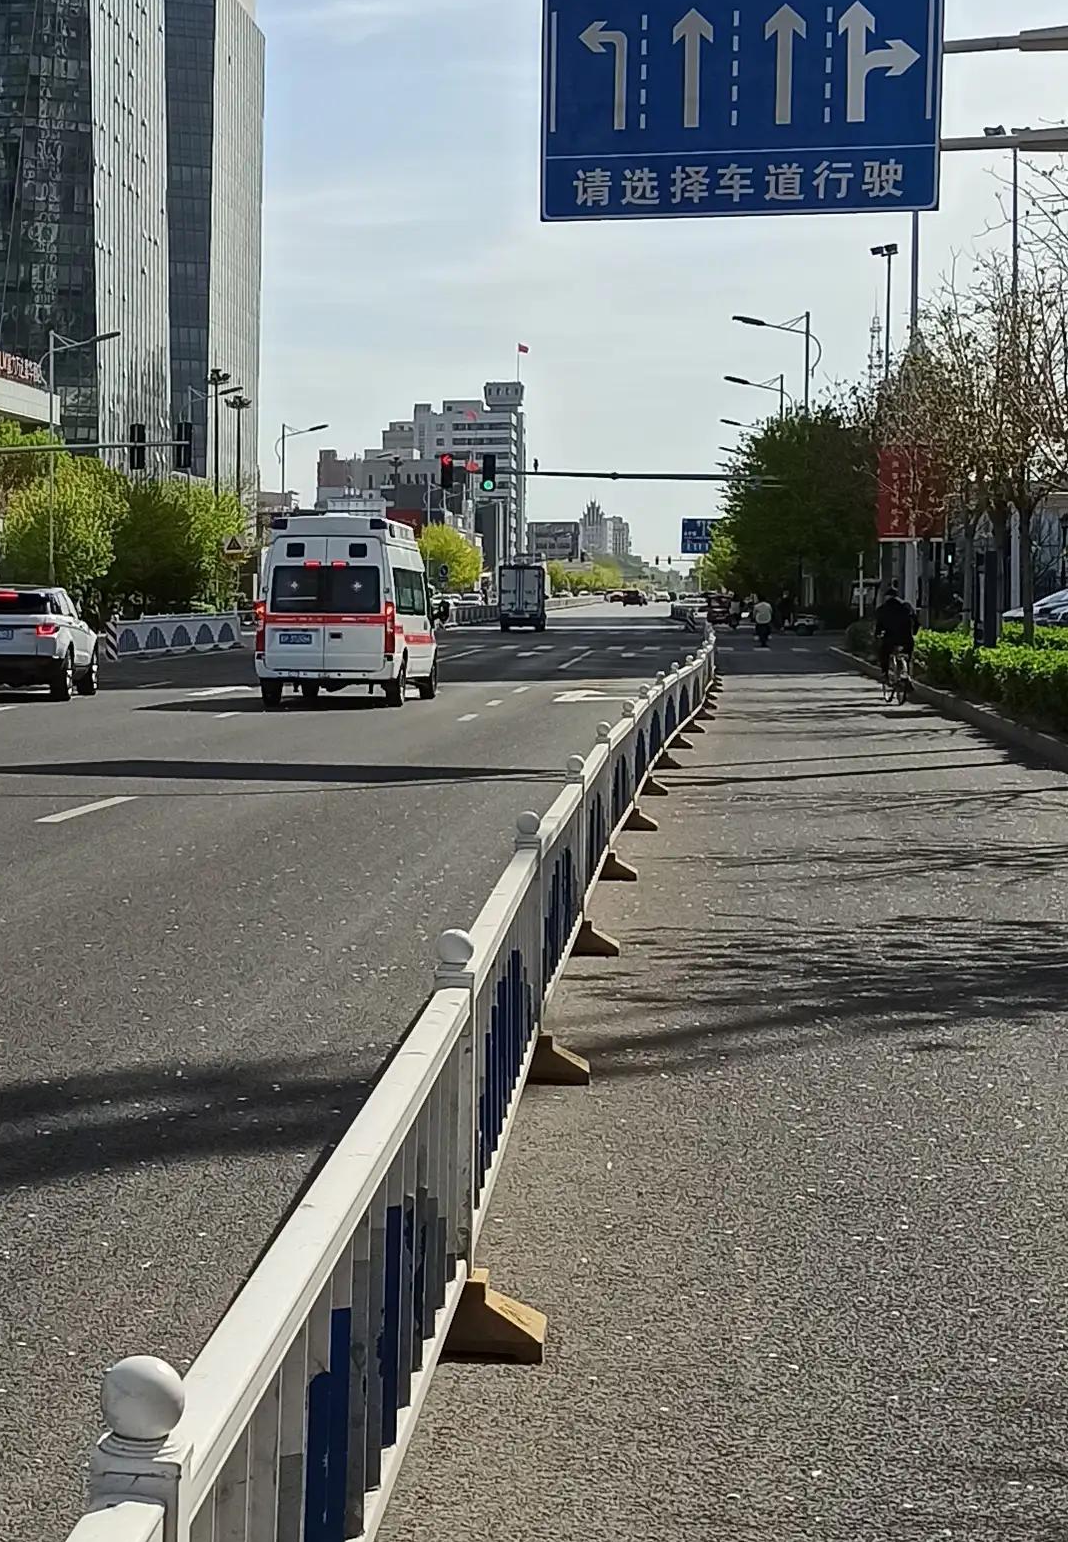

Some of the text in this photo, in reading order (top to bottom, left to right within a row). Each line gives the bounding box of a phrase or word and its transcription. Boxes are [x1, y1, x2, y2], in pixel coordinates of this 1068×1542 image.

[572, 158, 905, 207] 请选择车道行驶
